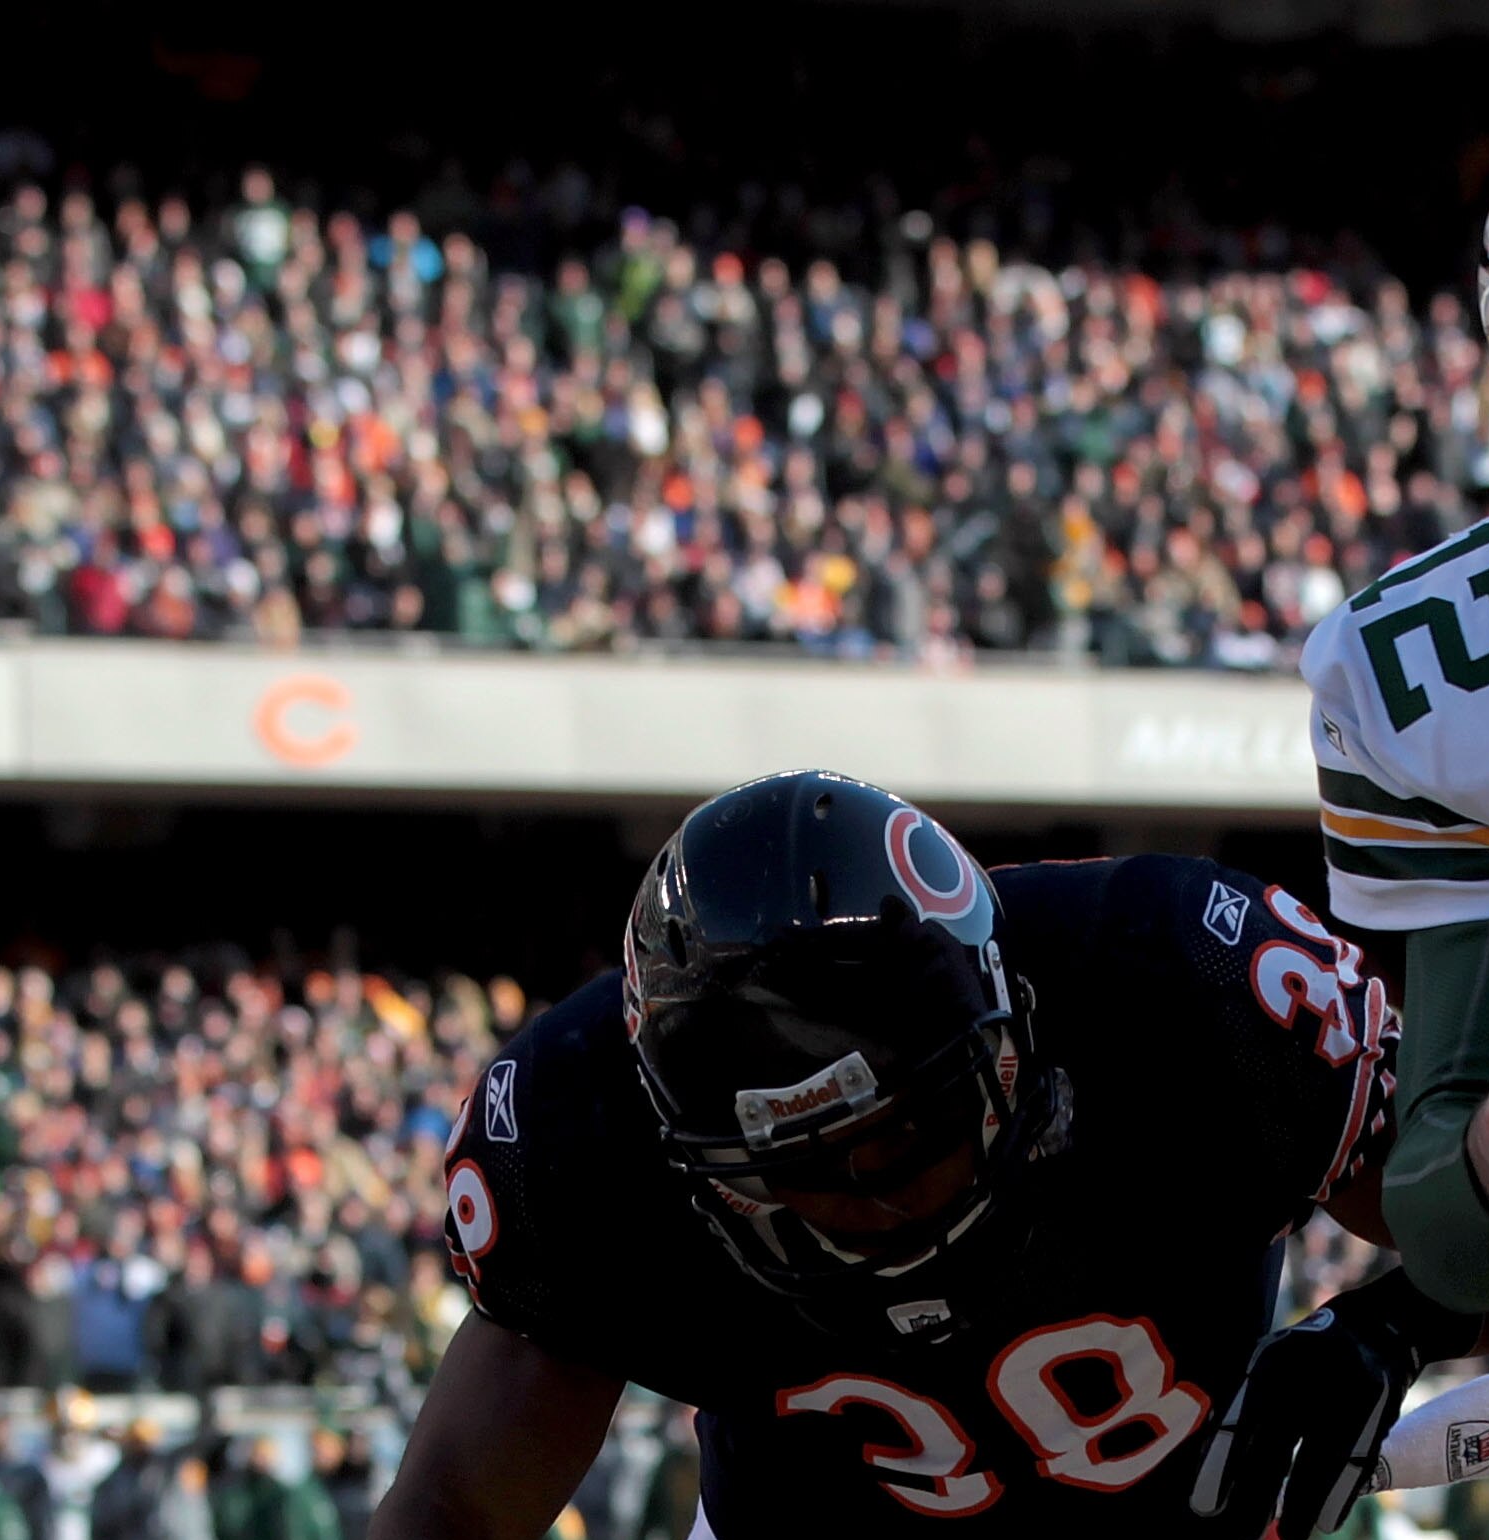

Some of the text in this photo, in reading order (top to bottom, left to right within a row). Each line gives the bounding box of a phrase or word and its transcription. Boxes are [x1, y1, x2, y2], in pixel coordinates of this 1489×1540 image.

[251, 673, 360, 770] C
[766, 1077, 844, 1119] Riddell
[776, 1312, 1211, 1519] 38
